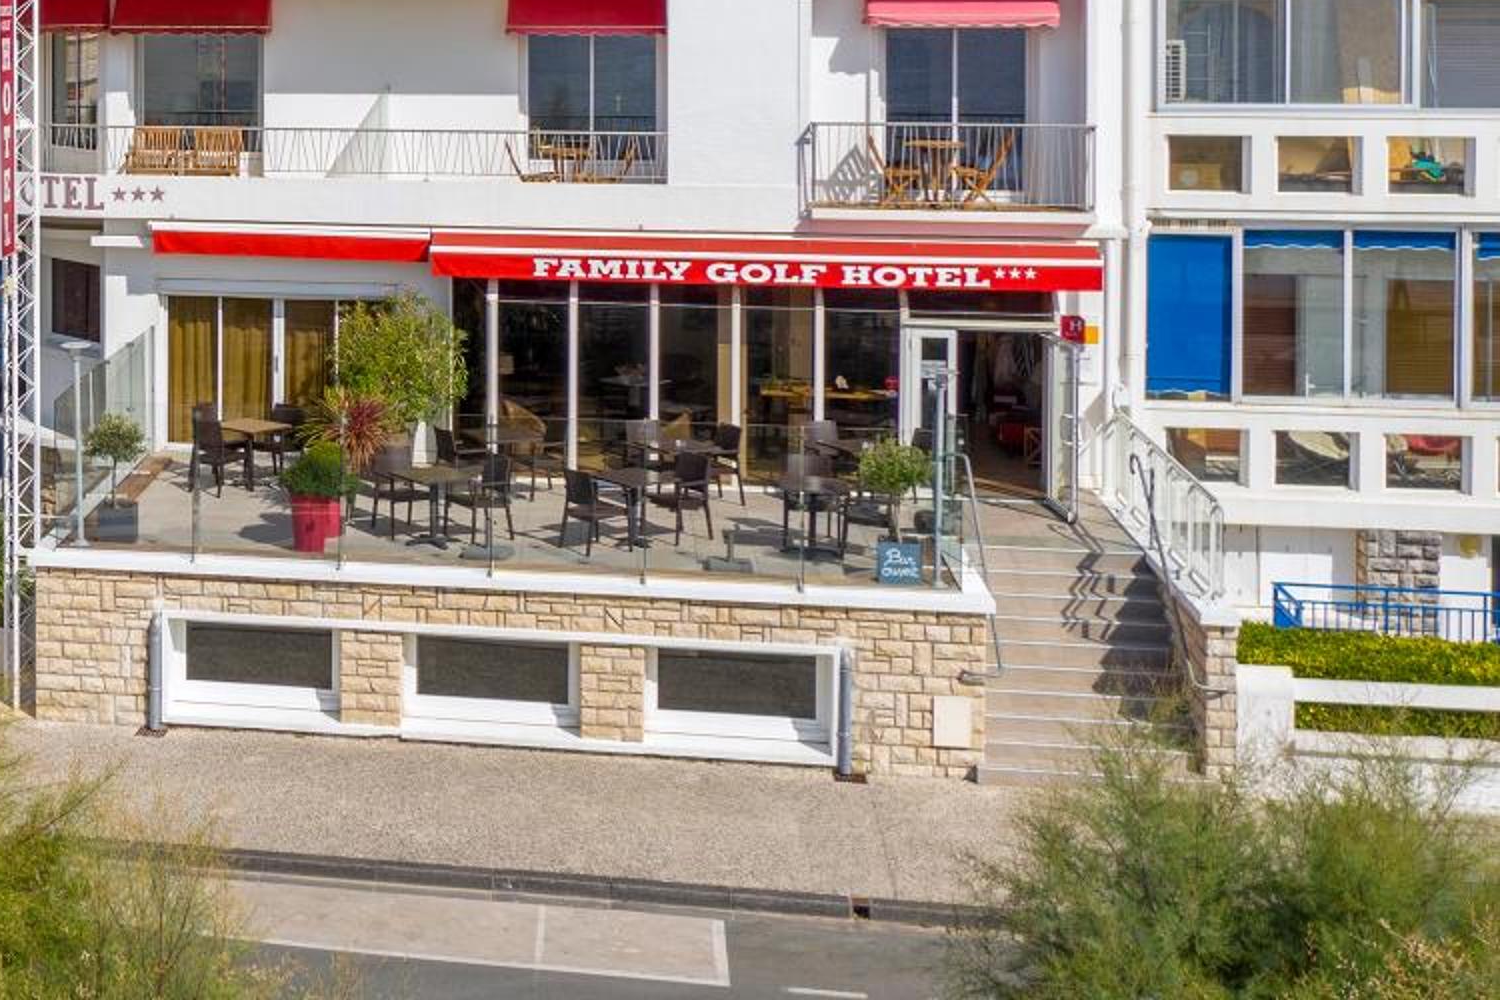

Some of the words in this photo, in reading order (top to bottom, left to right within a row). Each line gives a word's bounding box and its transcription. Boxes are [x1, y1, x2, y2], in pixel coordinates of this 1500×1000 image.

[1, 37, 11, 247] HOTEL
[533, 257, 692, 281] FAMILY
[706, 262, 827, 284] GOLF
[841, 264, 991, 288] HOTEL
